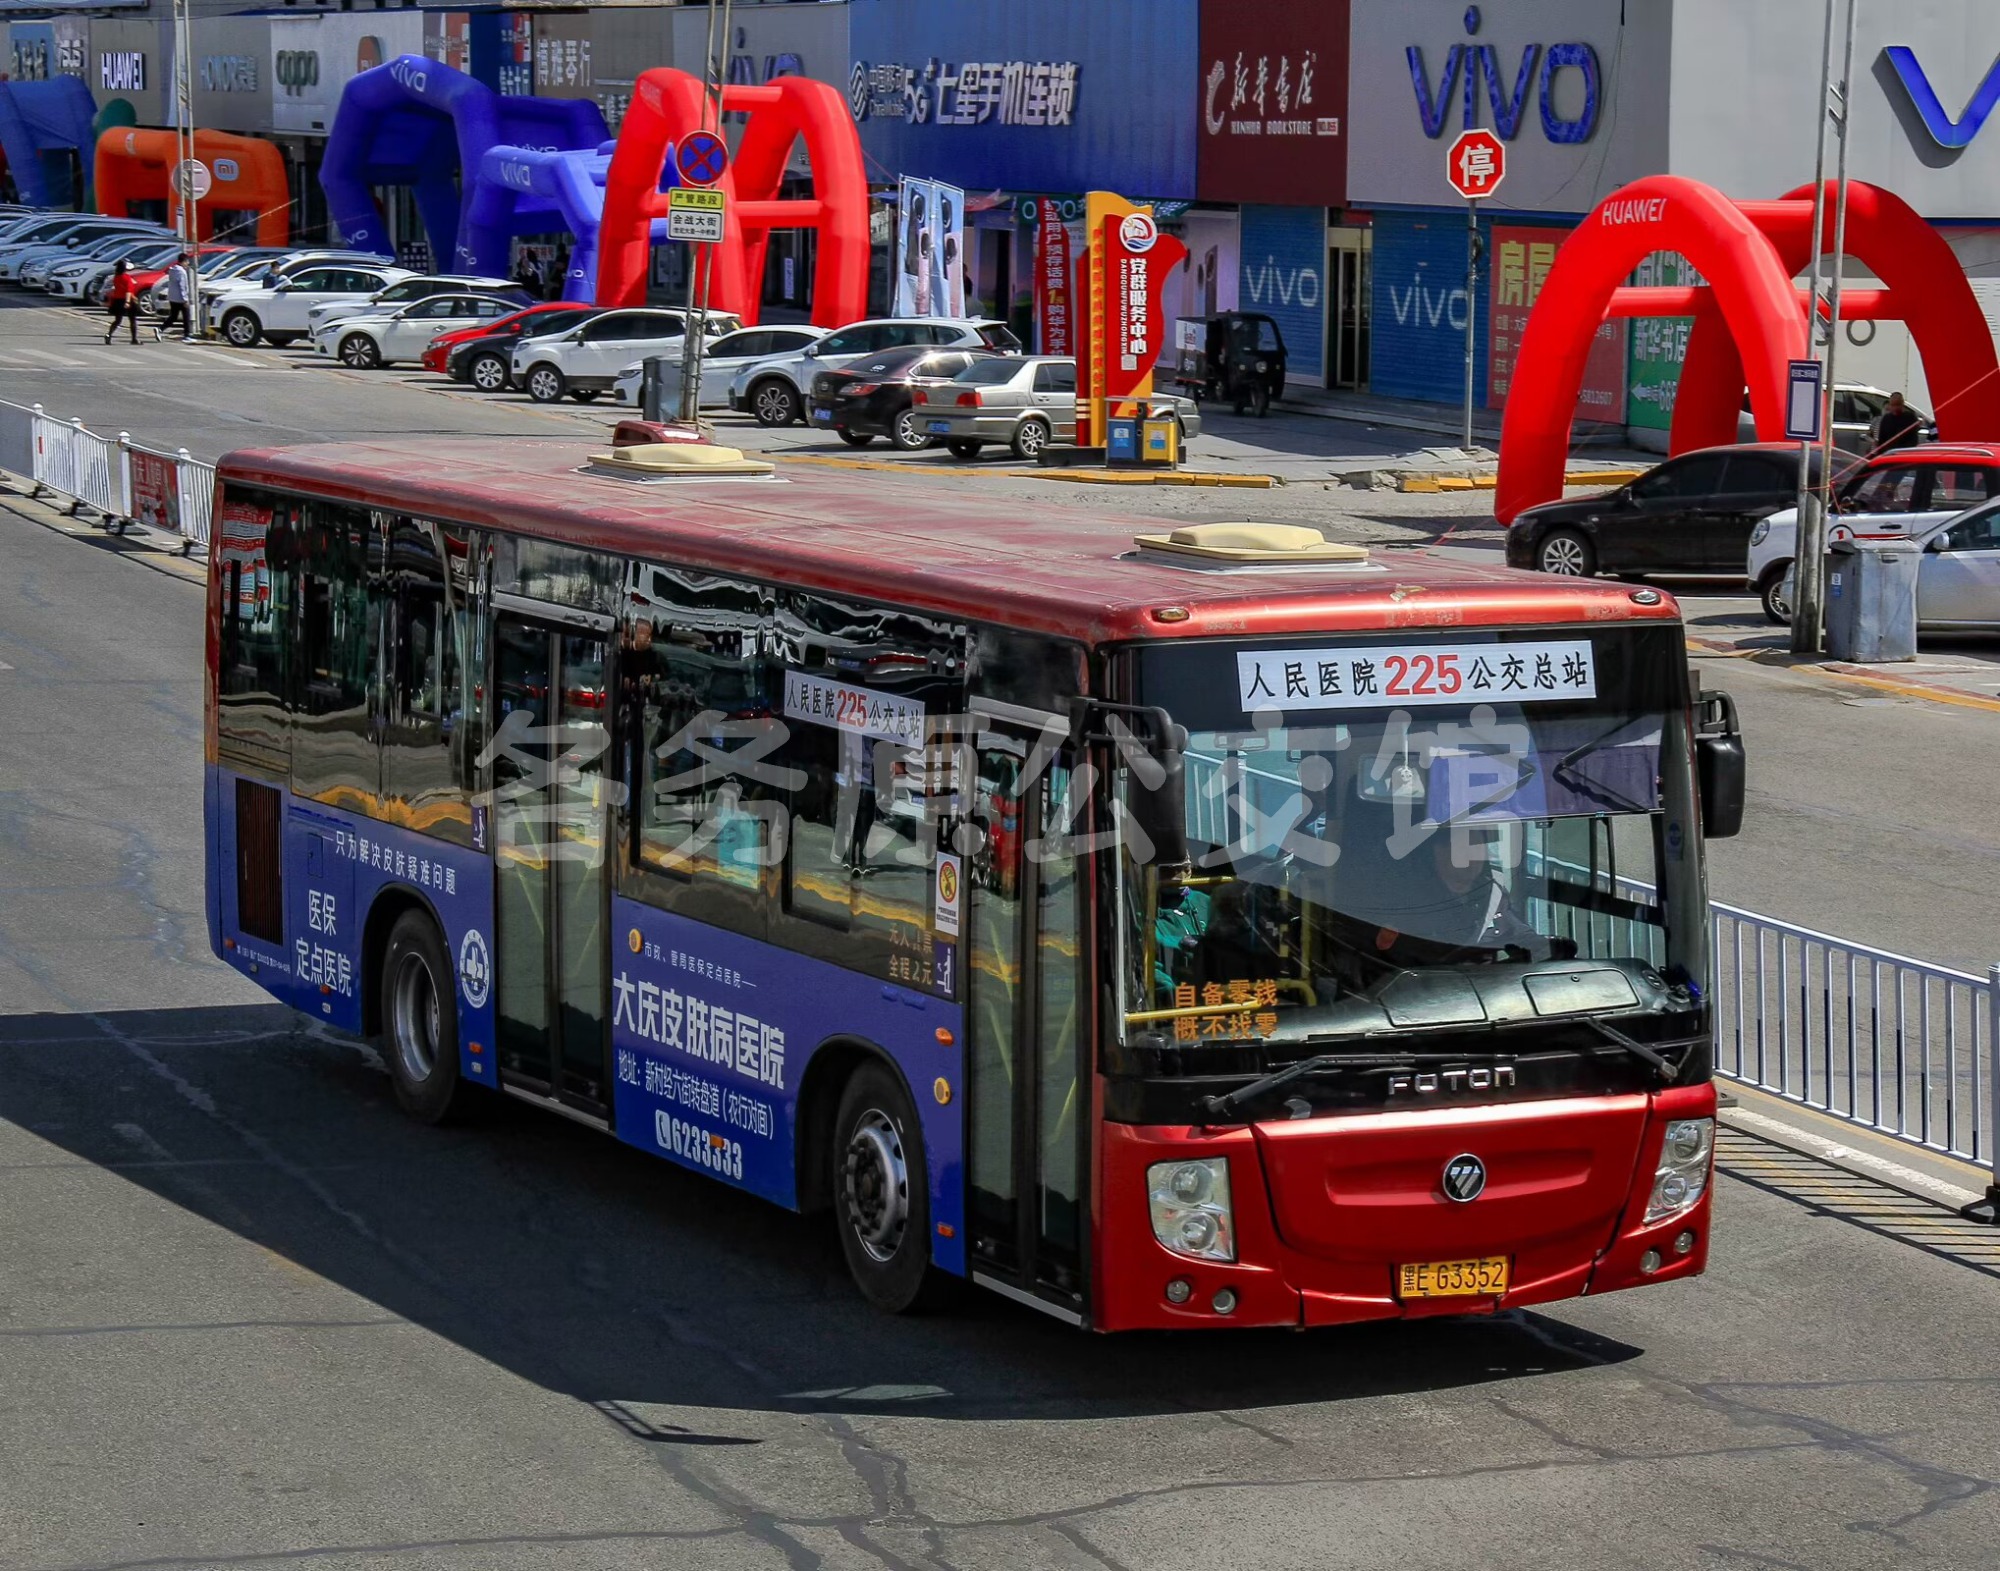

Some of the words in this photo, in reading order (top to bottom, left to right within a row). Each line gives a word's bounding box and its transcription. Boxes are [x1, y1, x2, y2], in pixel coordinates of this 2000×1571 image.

[101, 52, 144, 90] HUAWEI
[390, 59, 427, 93] vivo
[1231, 50, 1314, 116] 新华书店
[1405, 5, 1600, 144] vivo
[1266, 121, 1312, 135] BOOKSTORE
[501, 160, 531, 186] vivo
[1459, 143, 1494, 187] 停
[673, 214, 717, 227] 会战大街
[1602, 198, 1667, 227] HUAWEI
[1246, 256, 1319, 306] vivo
[1390, 273, 1469, 329] vivo
[1130, 258, 1147, 354] 党群服务中心
[1247, 658, 1379, 699] 人民医院
[1383, 654, 1463, 696] 225
[1467, 651, 1589, 690] 公交总站
[786, 679, 835, 718] 人民医院
[836, 689, 868, 728] 225
[869, 700, 921, 740] 公交总站
[308, 888, 337, 937] 医保
[296, 936, 352, 997] 定点医院
[888, 953, 933, 986] 全程2元
[1174, 979, 1277, 1008] 自备零钱
[613, 971, 785, 1090] 大庆皮肤病医院
[1173, 1011, 1278, 1041] 概不找零
[1388, 1066, 1516, 1096] FOTON
